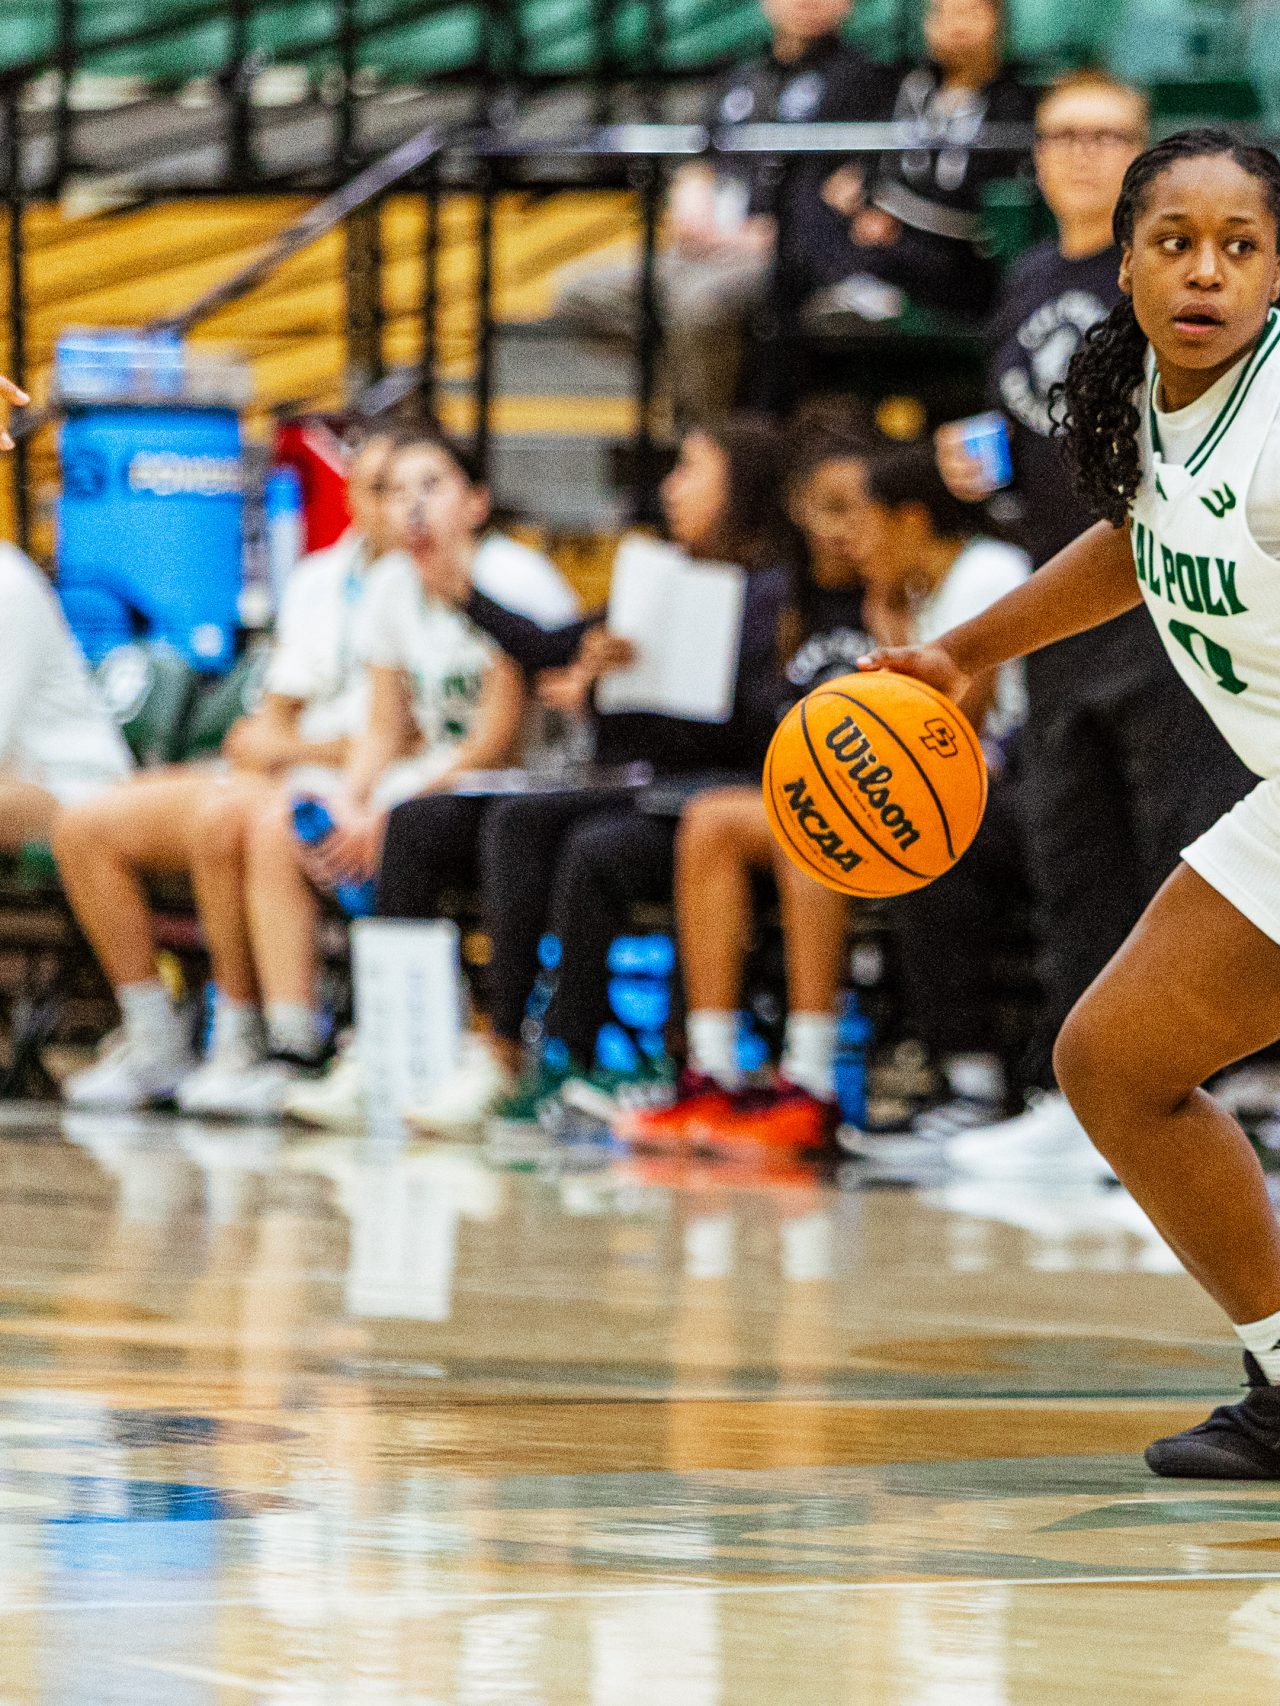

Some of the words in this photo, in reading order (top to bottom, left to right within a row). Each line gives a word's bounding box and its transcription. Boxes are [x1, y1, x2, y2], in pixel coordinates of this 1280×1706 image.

[1130, 515, 1161, 596] AL
[1161, 543, 1249, 616] POLY
[783, 777, 863, 873] NCAA
[825, 715, 921, 851] Wilson
